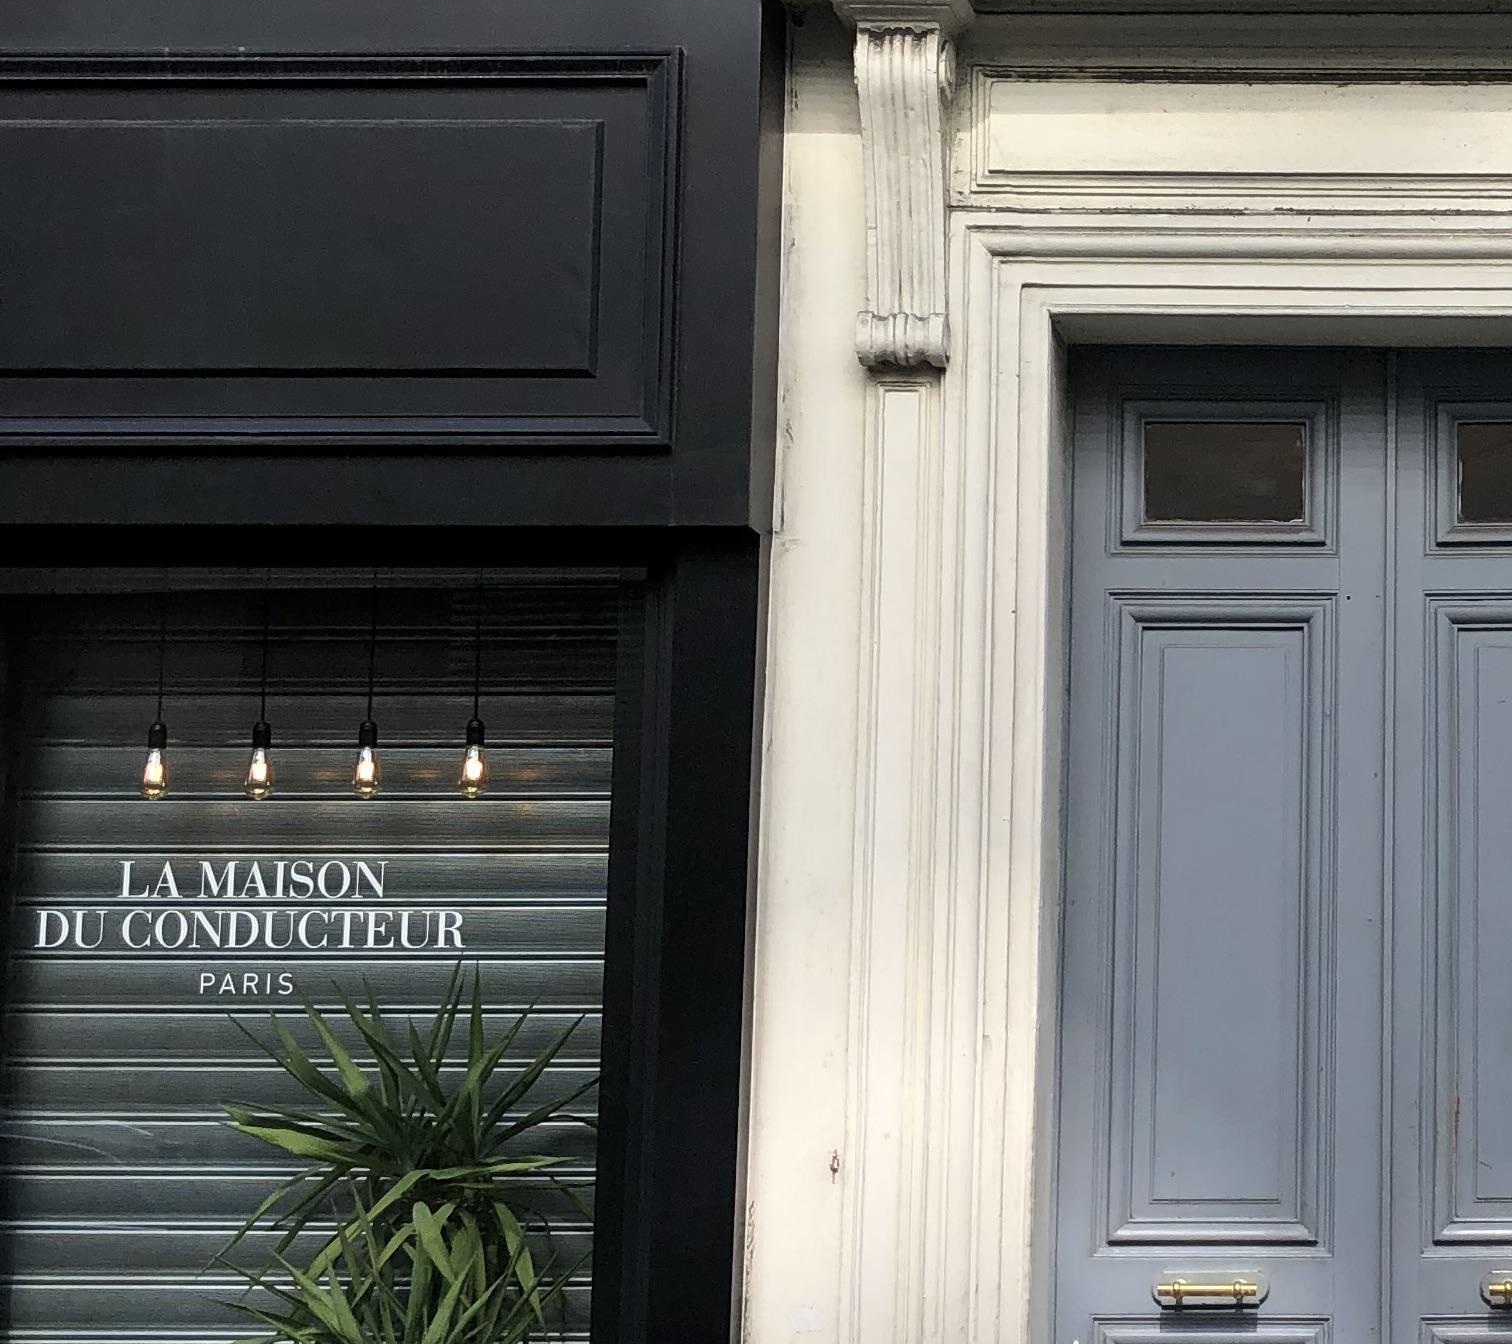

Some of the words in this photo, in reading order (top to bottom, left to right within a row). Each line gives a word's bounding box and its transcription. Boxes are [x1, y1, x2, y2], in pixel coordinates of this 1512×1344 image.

[118, 861, 183, 898] LA
[197, 860, 389, 898] MAISON
[34, 910, 106, 948] DU
[121, 910, 466, 948] CONDUCTEUR
[200, 973, 294, 995] PARIS
